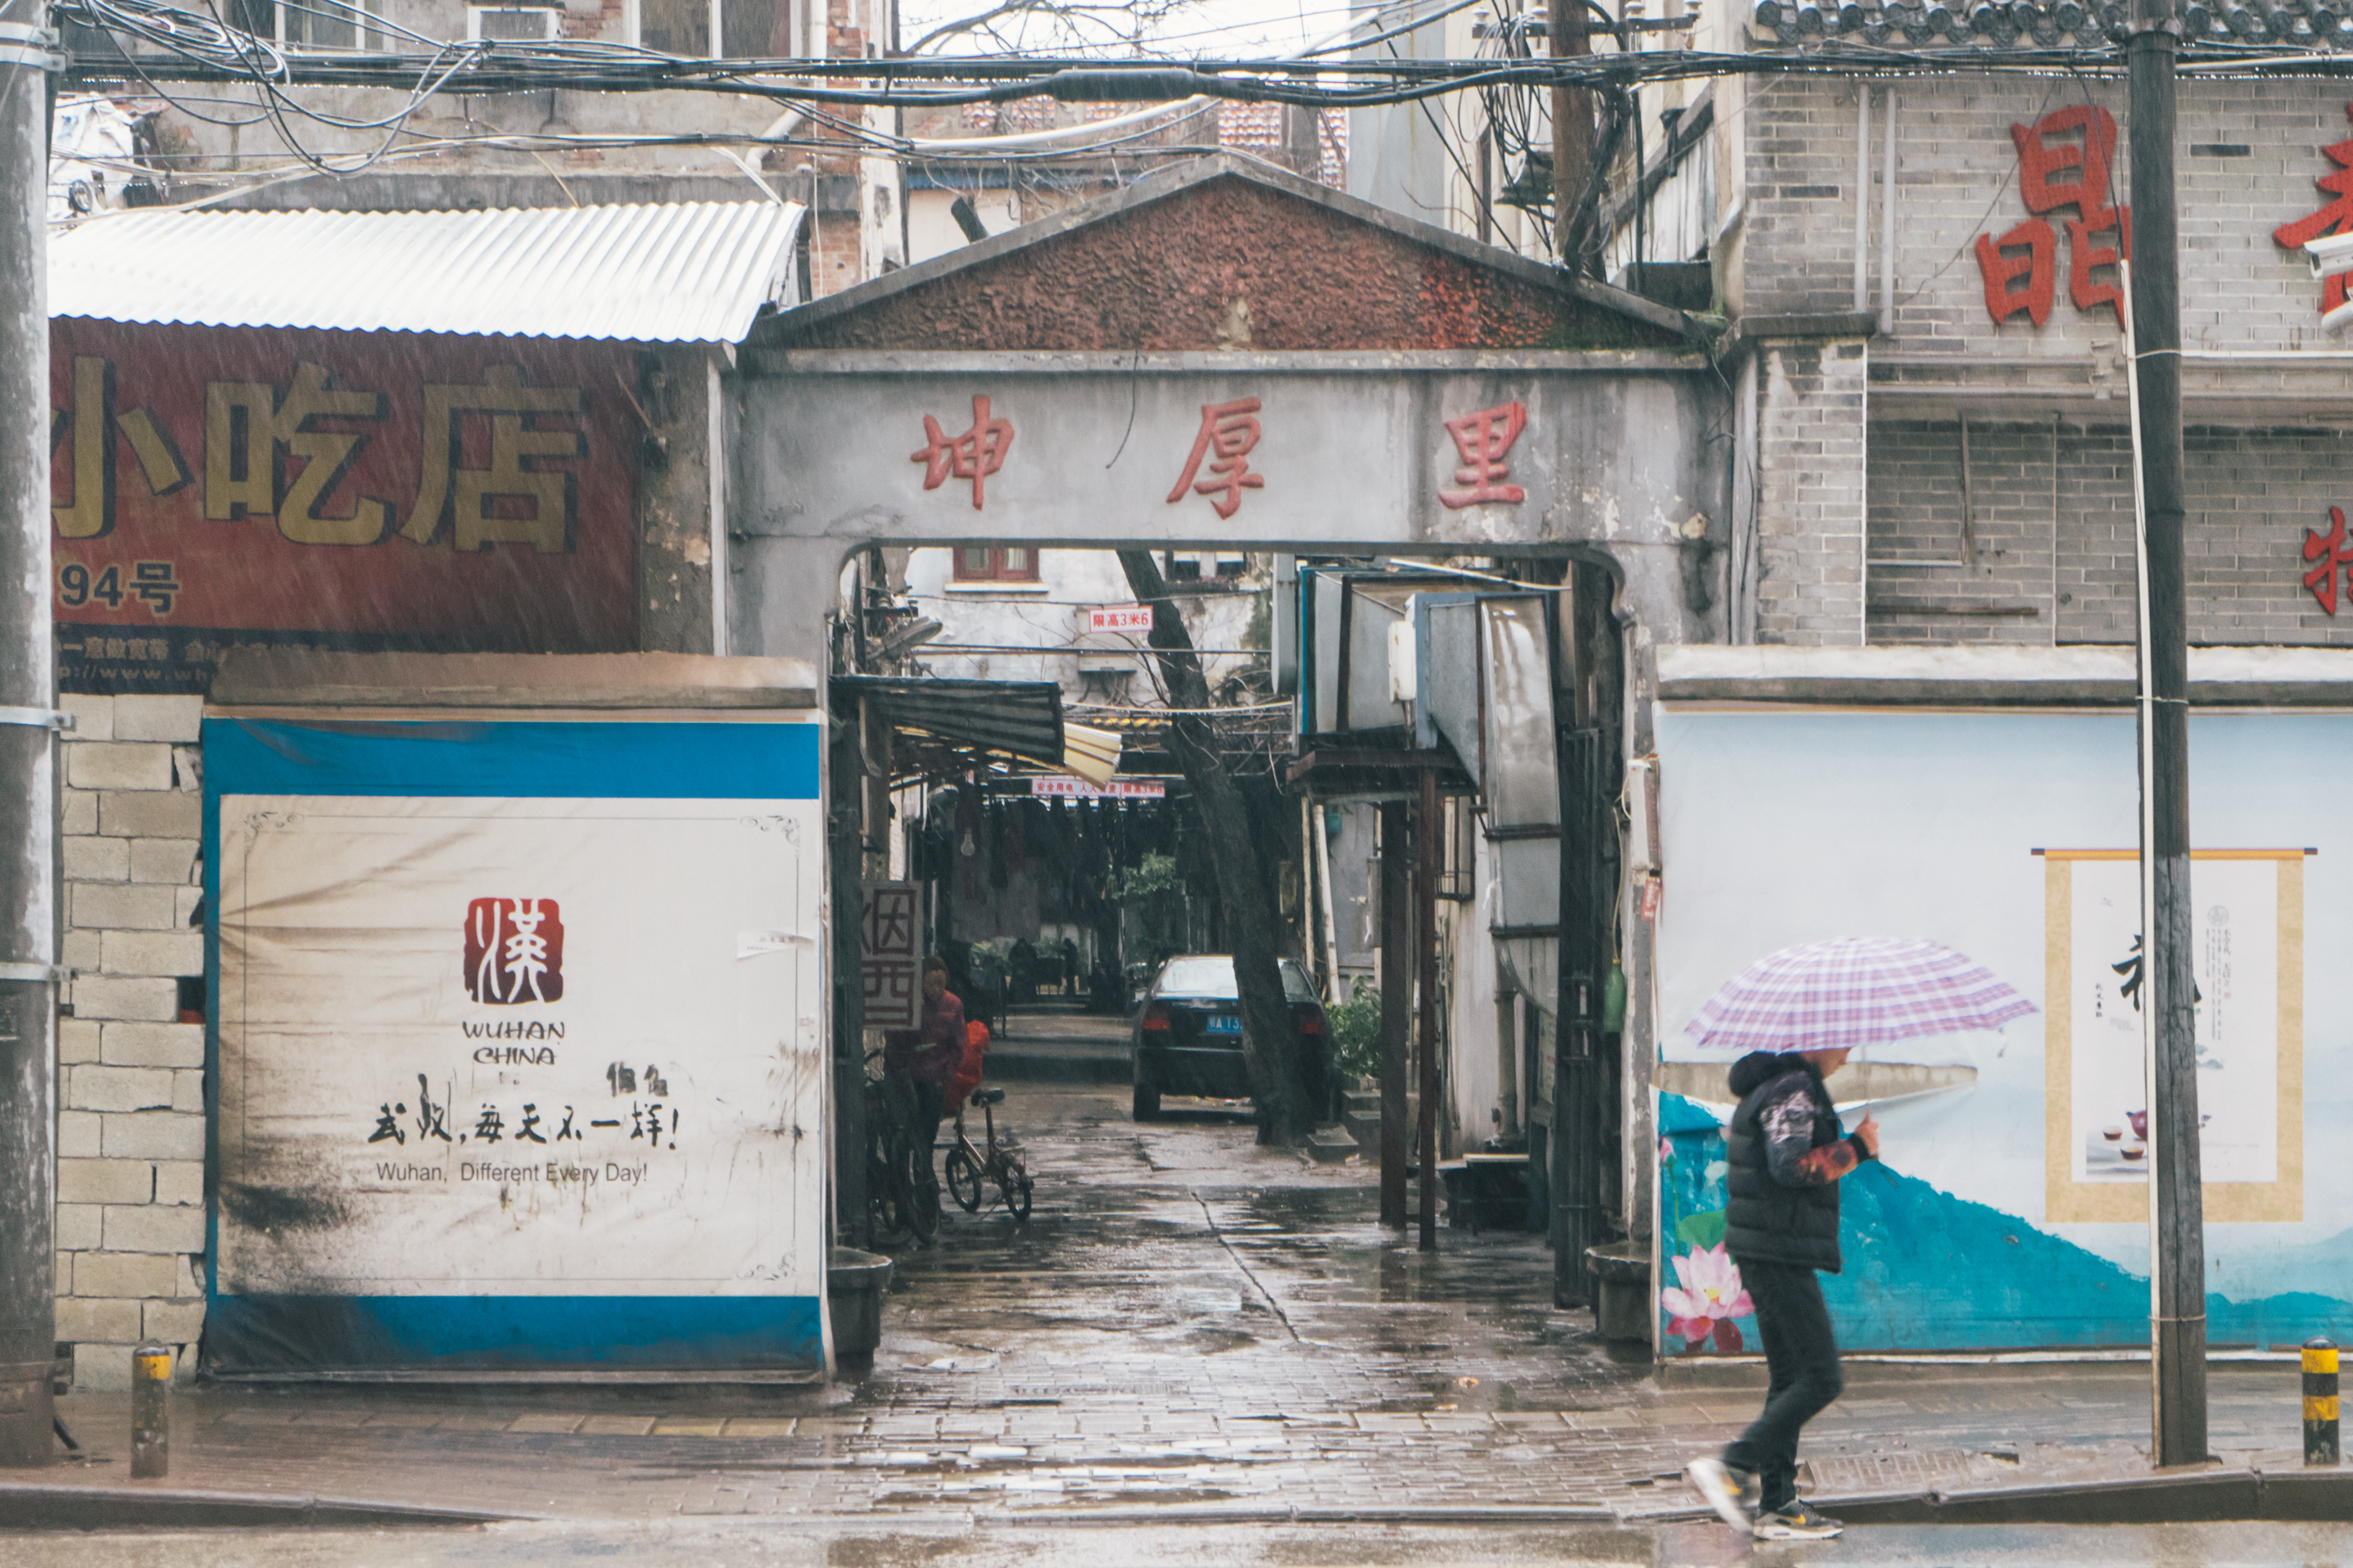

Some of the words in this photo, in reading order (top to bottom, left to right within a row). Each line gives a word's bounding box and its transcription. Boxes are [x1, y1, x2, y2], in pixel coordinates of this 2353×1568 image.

[51, 355, 583, 554] 小吃店
[910, 394, 1528, 520] 坤厚里
[61, 562, 179, 614] 94号
[1093, 612, 1149, 628] 限高3米6
[1036, 782, 1074, 793] 安全用电
[1079, 782, 1116, 794] 人人责
[462, 1020, 565, 1041] WUHAN
[473, 1046, 556, 1066] CHINA
[376, 1162, 448, 1184] Wuhan,
[460, 1162, 539, 1182] Different
[545, 1162, 599, 1186] Every
[605, 1162, 649, 1186] Day!
